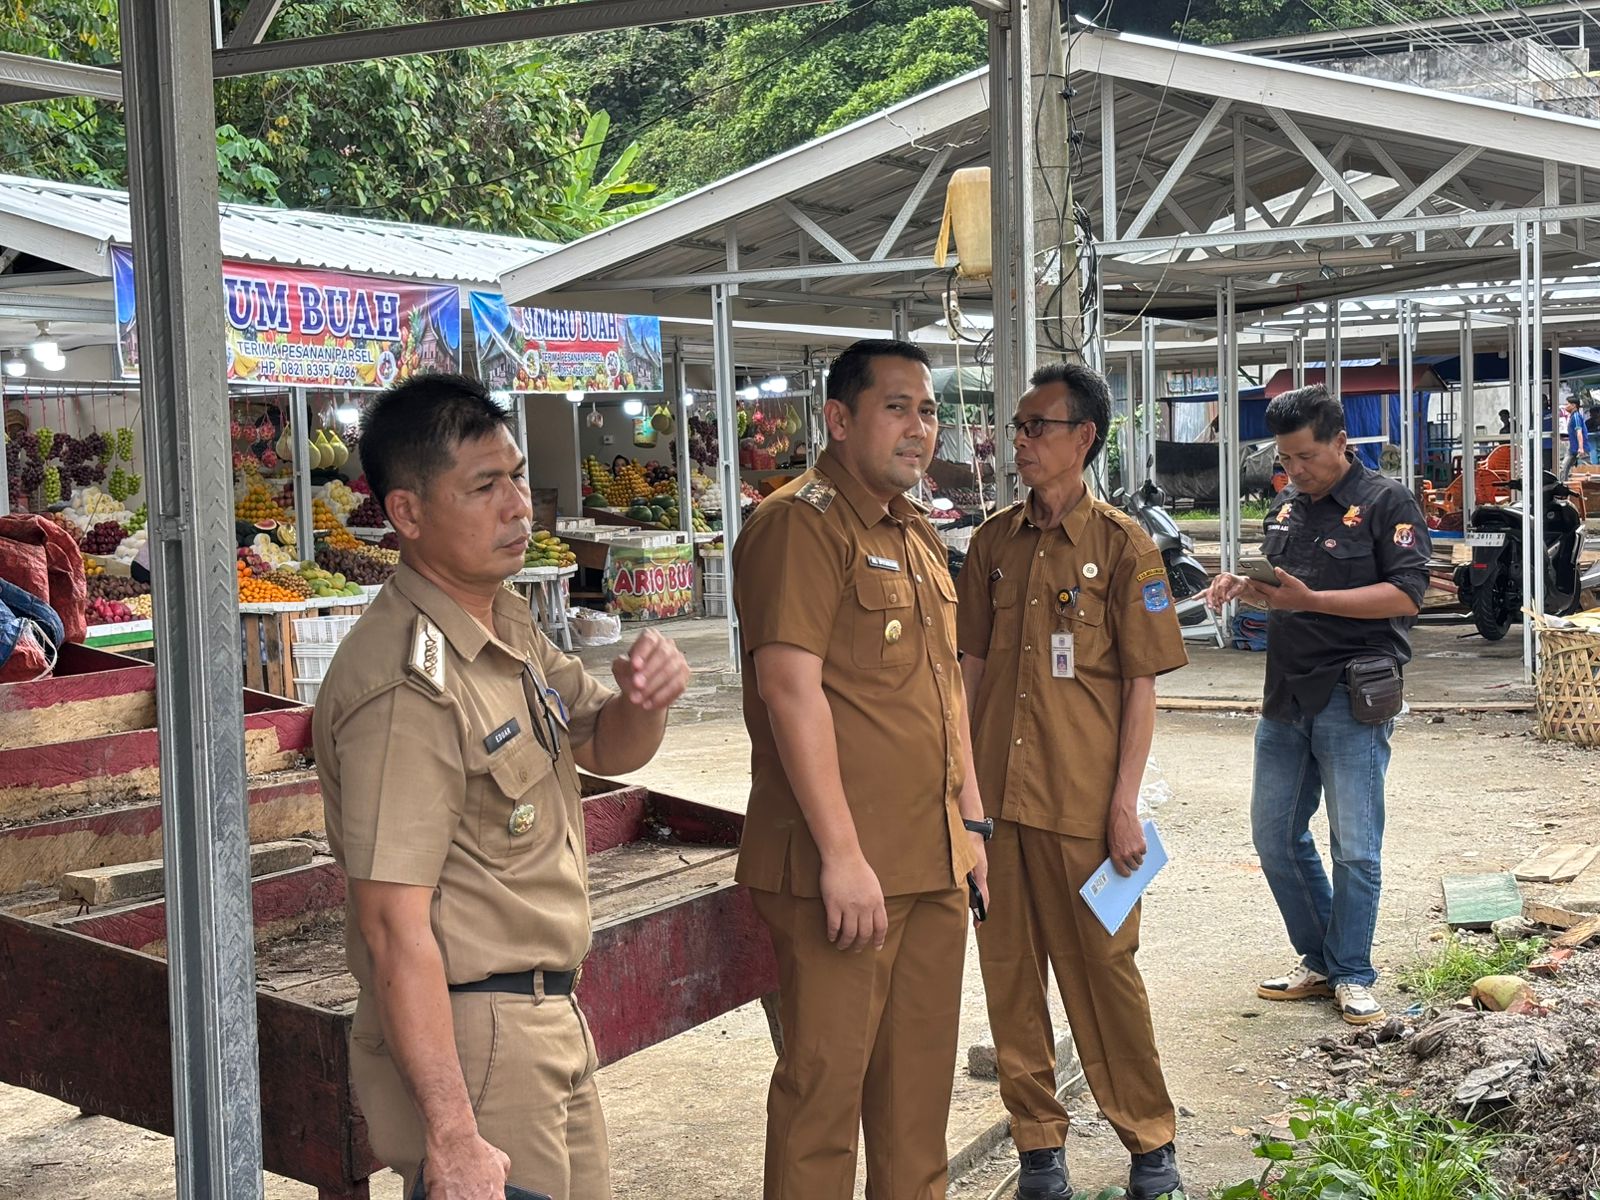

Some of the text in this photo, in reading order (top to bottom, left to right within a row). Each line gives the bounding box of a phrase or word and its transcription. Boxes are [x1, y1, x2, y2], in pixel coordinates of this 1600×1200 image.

[224, 277, 400, 339] UM BUAH
[580, 311, 619, 342] BUAH
[237, 341, 374, 363] TERIMA PESANAN PARSEL
[261, 361, 356, 379] HP. 0821 8395 4286
[614, 567, 665, 595] ARIO
